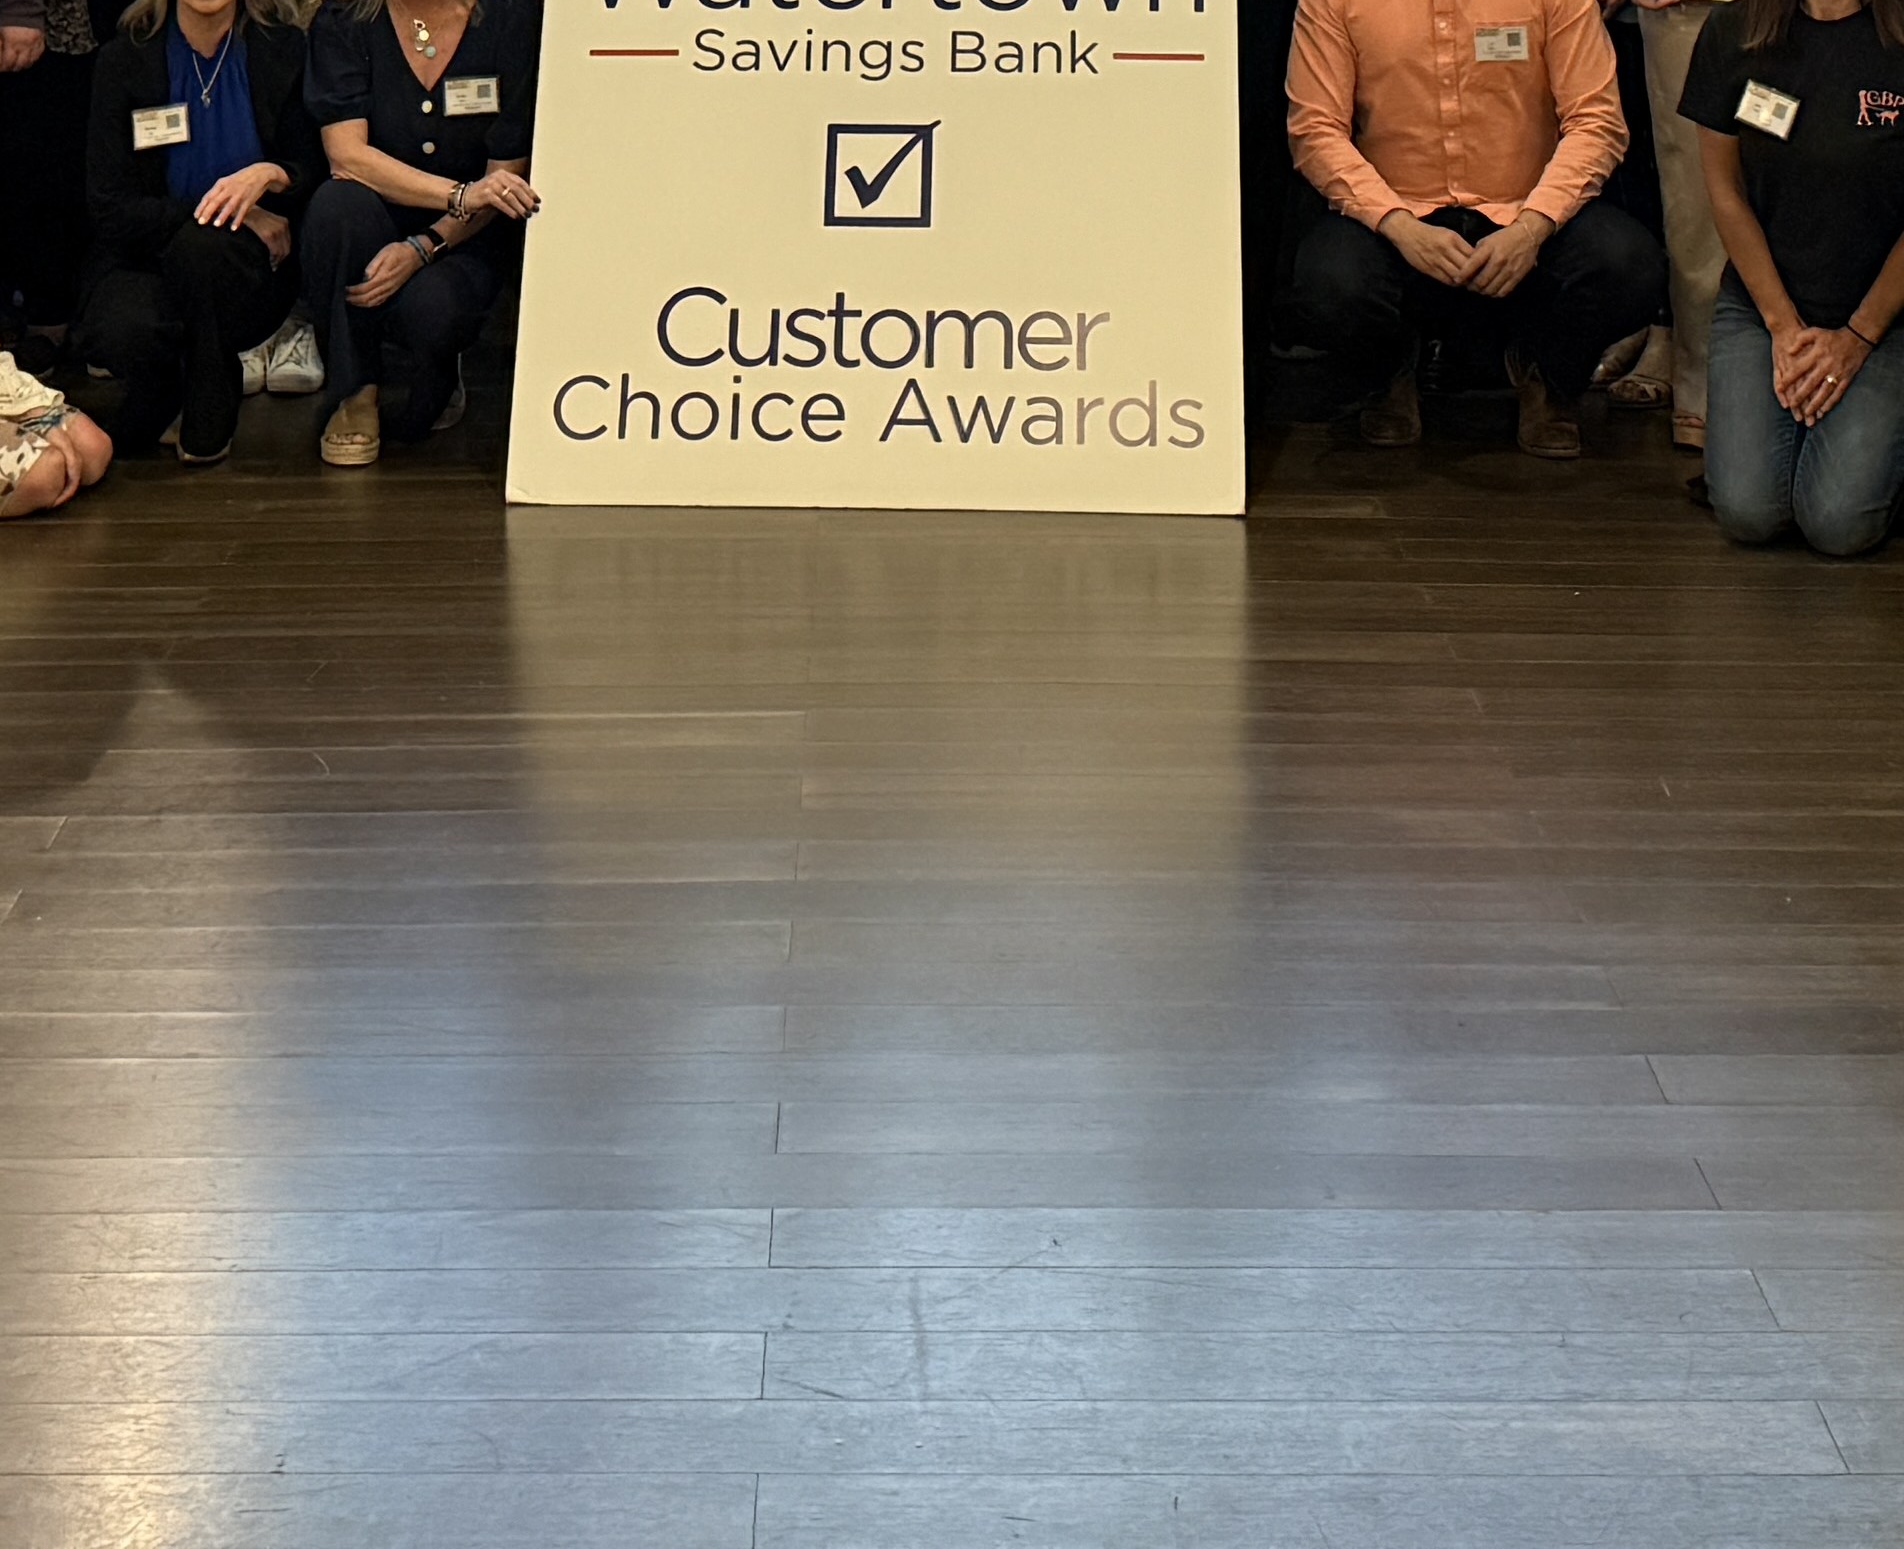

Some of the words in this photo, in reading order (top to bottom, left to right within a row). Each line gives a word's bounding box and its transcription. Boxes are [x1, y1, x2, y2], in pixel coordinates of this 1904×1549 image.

[691, 28, 926, 81] Savings
[949, 28, 1100, 75] Bank
[656, 286, 1111, 372] Customer
[552, 372, 847, 443] Choice
[878, 376, 1206, 450] Awards
